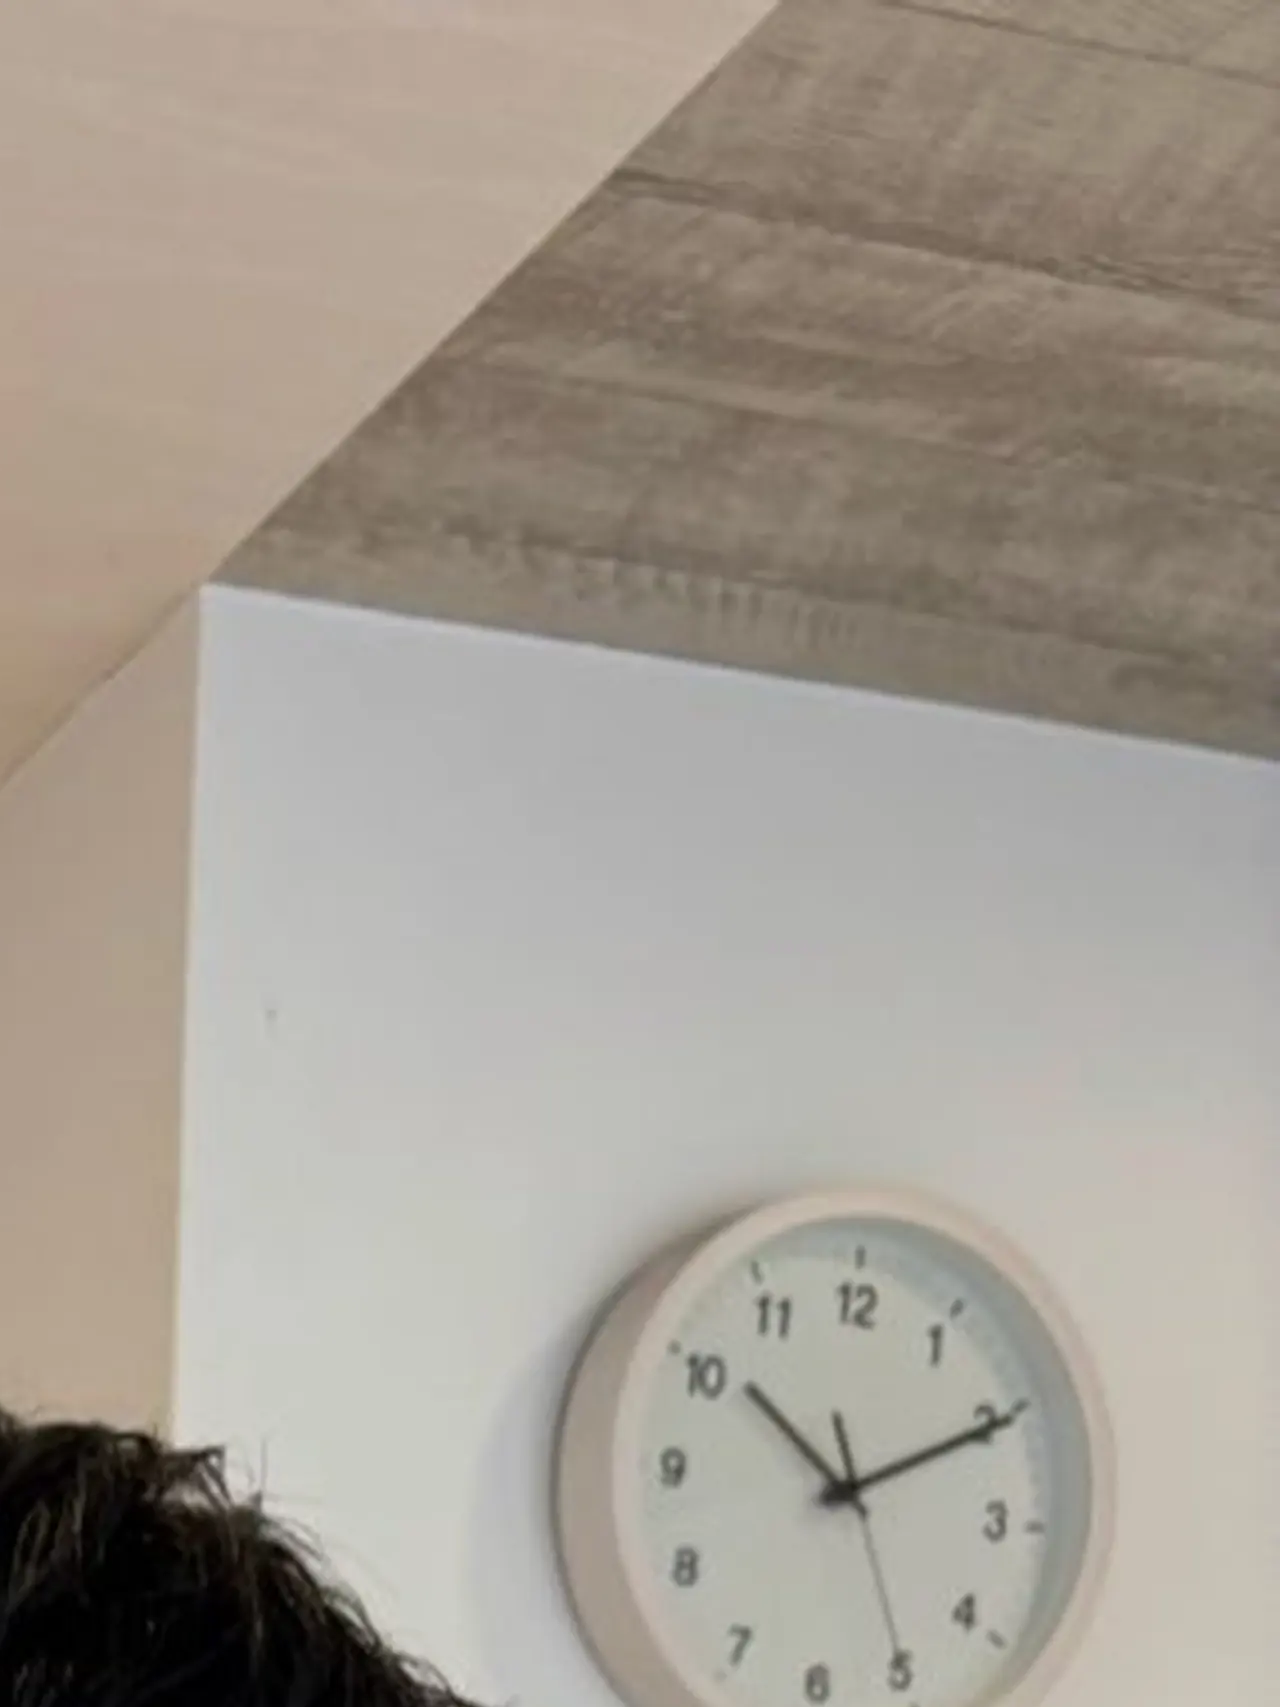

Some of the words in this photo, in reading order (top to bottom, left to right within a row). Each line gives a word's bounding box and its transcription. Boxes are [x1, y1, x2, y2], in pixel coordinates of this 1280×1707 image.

[756, 1293, 792, 1338] 11
[837, 1282, 878, 1330] 12
[927, 1324, 943, 1366] 1
[686, 1354, 726, 1399] 10
[660, 1447, 687, 1488] 9
[982, 1500, 1008, 1544] 3
[672, 1547, 699, 1588] 8
[952, 1593, 977, 1632] 4
[727, 1625, 753, 1666] 7
[804, 1663, 831, 1704] 6
[887, 1650, 913, 1691] 5
